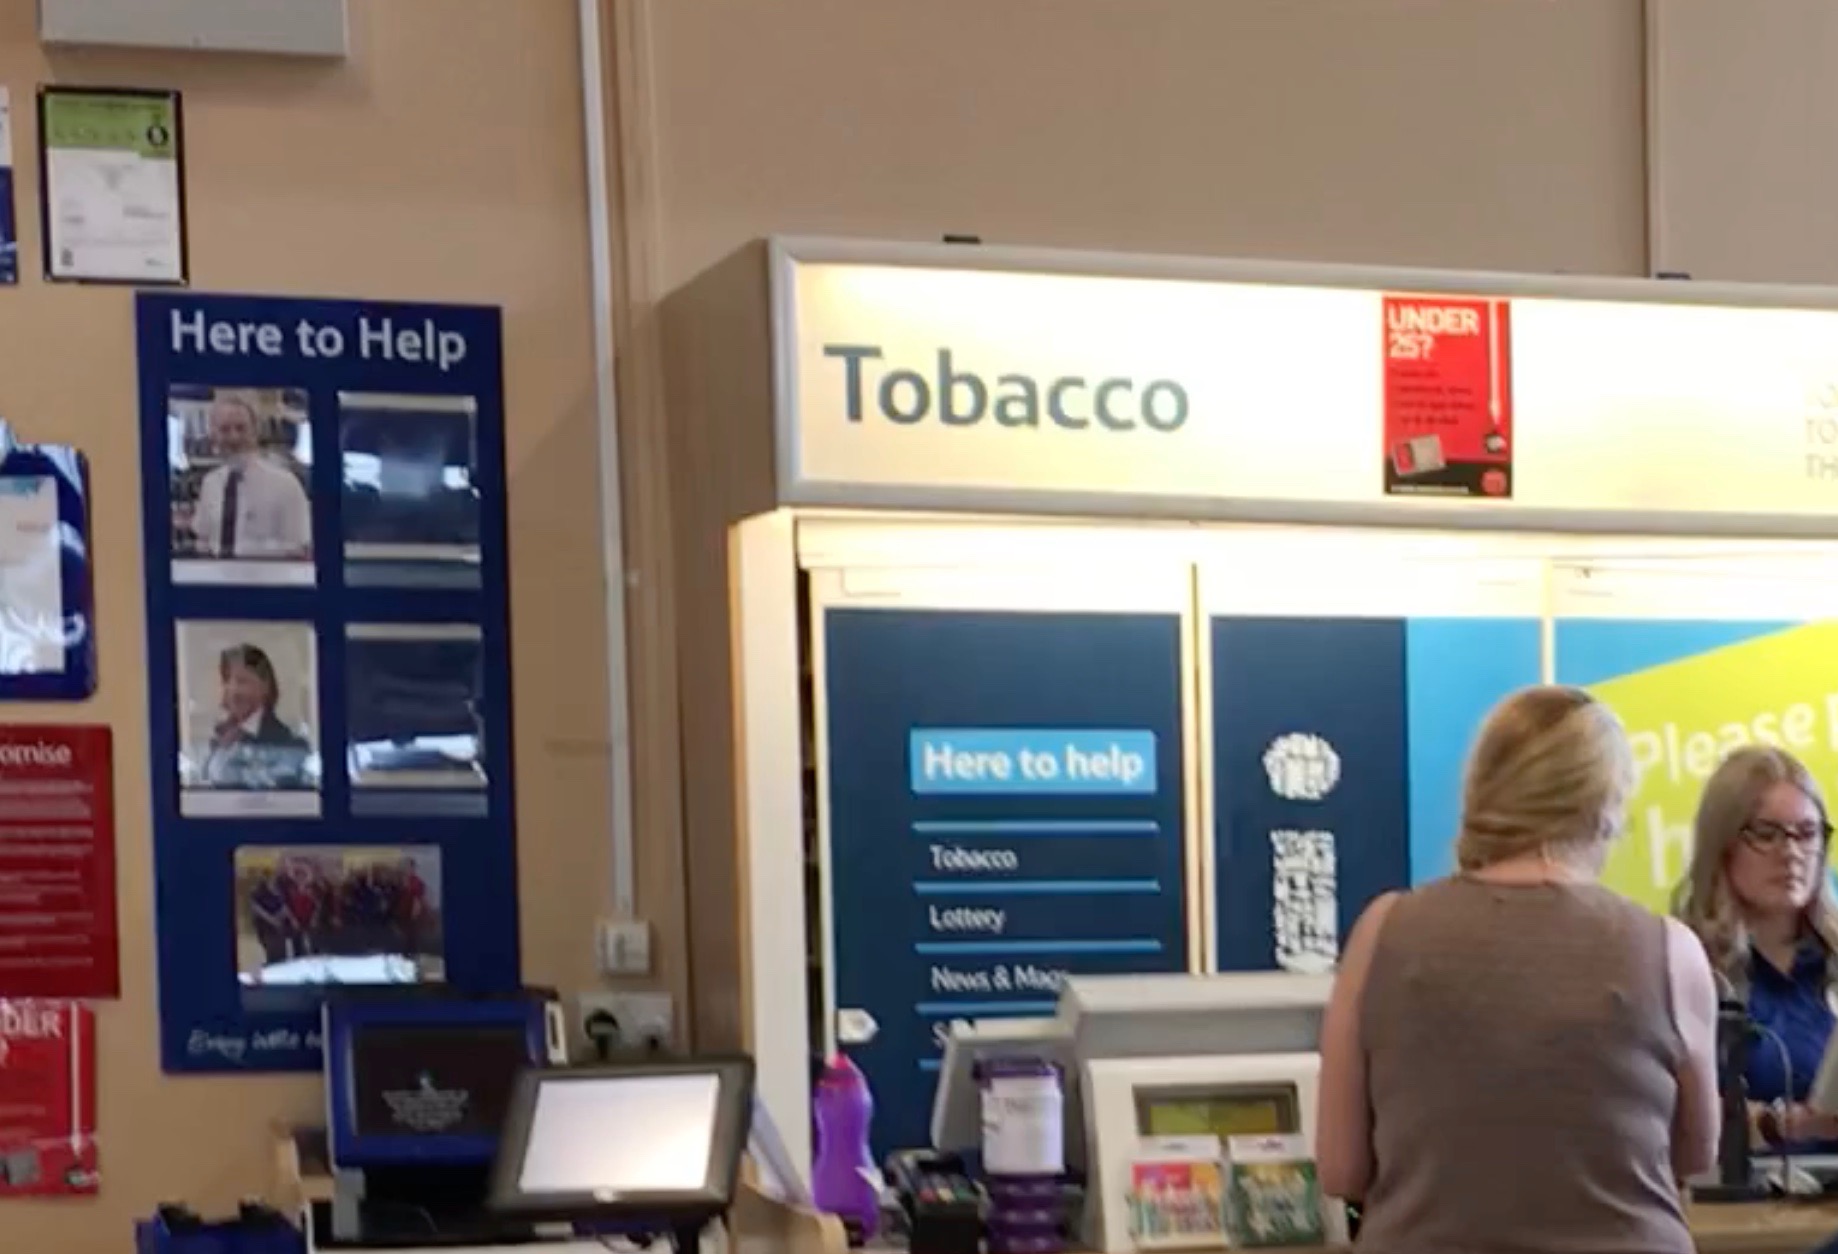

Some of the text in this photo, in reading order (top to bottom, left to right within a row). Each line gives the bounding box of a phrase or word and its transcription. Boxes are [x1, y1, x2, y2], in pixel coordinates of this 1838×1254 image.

[1388, 304, 1480, 336] UNDER
[171, 309, 468, 371] Here to Help
[823, 343, 1190, 432] Tobacco
[1805, 416, 1838, 444] TO
[923, 741, 1144, 784] Here to help
[1629, 702, 1816, 797] Please
[929, 843, 1020, 871] Tobacco
[929, 903, 1007, 935] Lottery
[931, 963, 1068, 994] News & Mag
